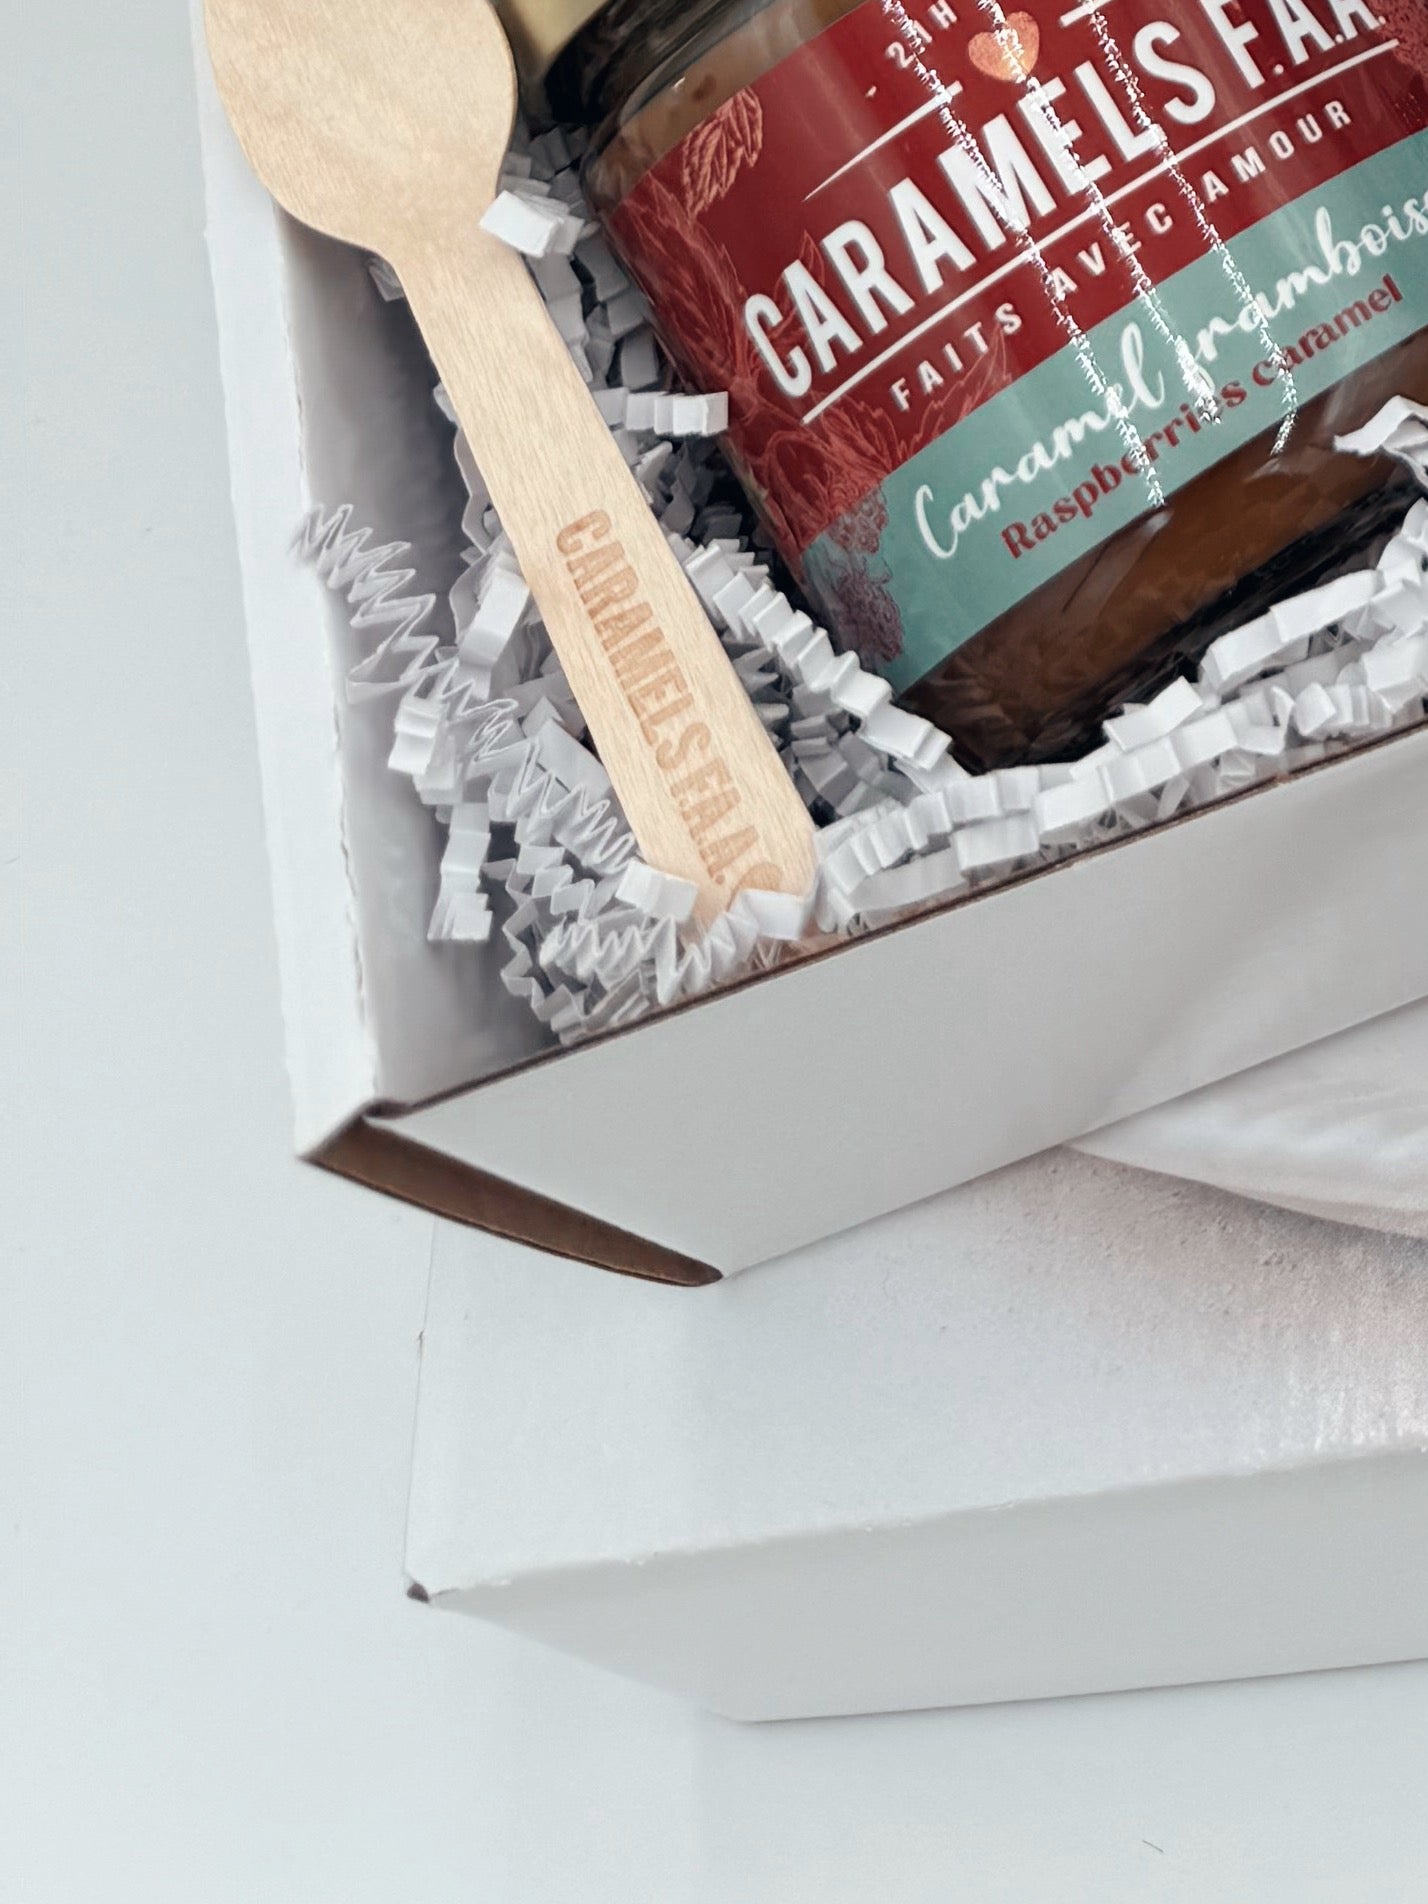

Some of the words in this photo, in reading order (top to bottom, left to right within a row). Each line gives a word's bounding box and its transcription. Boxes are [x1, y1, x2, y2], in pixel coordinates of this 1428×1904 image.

[743, 19, 1219, 399] CARAMELS
[889, 300, 1023, 412] FAITS
[1051, 204, 1174, 300] AVEC
[1206, 100, 1355, 198] AMOUR
[915, 322, 1166, 560] Caramel
[555, 508, 713, 773] CARAMELS
